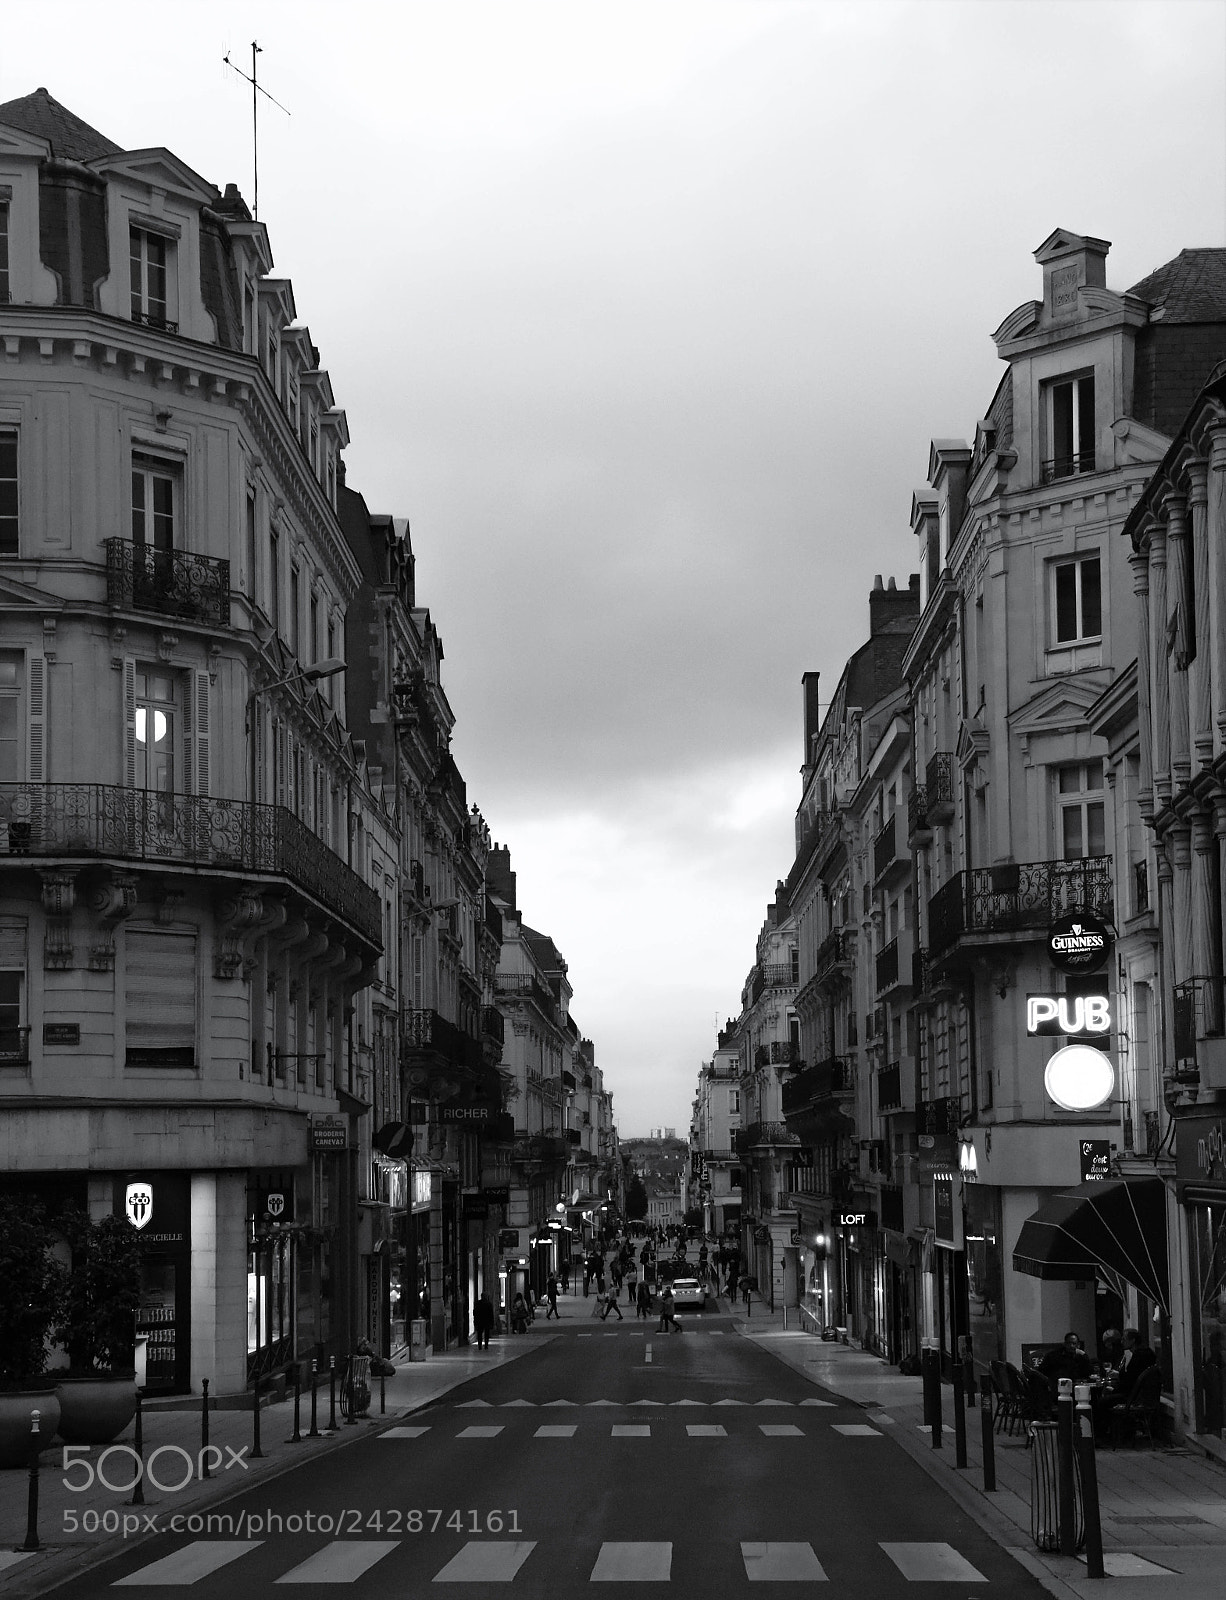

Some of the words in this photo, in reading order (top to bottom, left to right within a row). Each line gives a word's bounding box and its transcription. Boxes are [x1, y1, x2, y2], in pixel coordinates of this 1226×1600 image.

[1051, 935, 1104, 949] GUINNESS
[1027, 995, 1111, 1033] PUB
[443, 1108, 488, 1119] RICHER
[315, 1120, 343, 1128] DMC
[314, 1130, 345, 1138] BRODERIE
[315, 1138, 344, 1146] CANEVAS
[129, 1196, 150, 1206] SCO
[840, 1214, 866, 1225] LOFT
